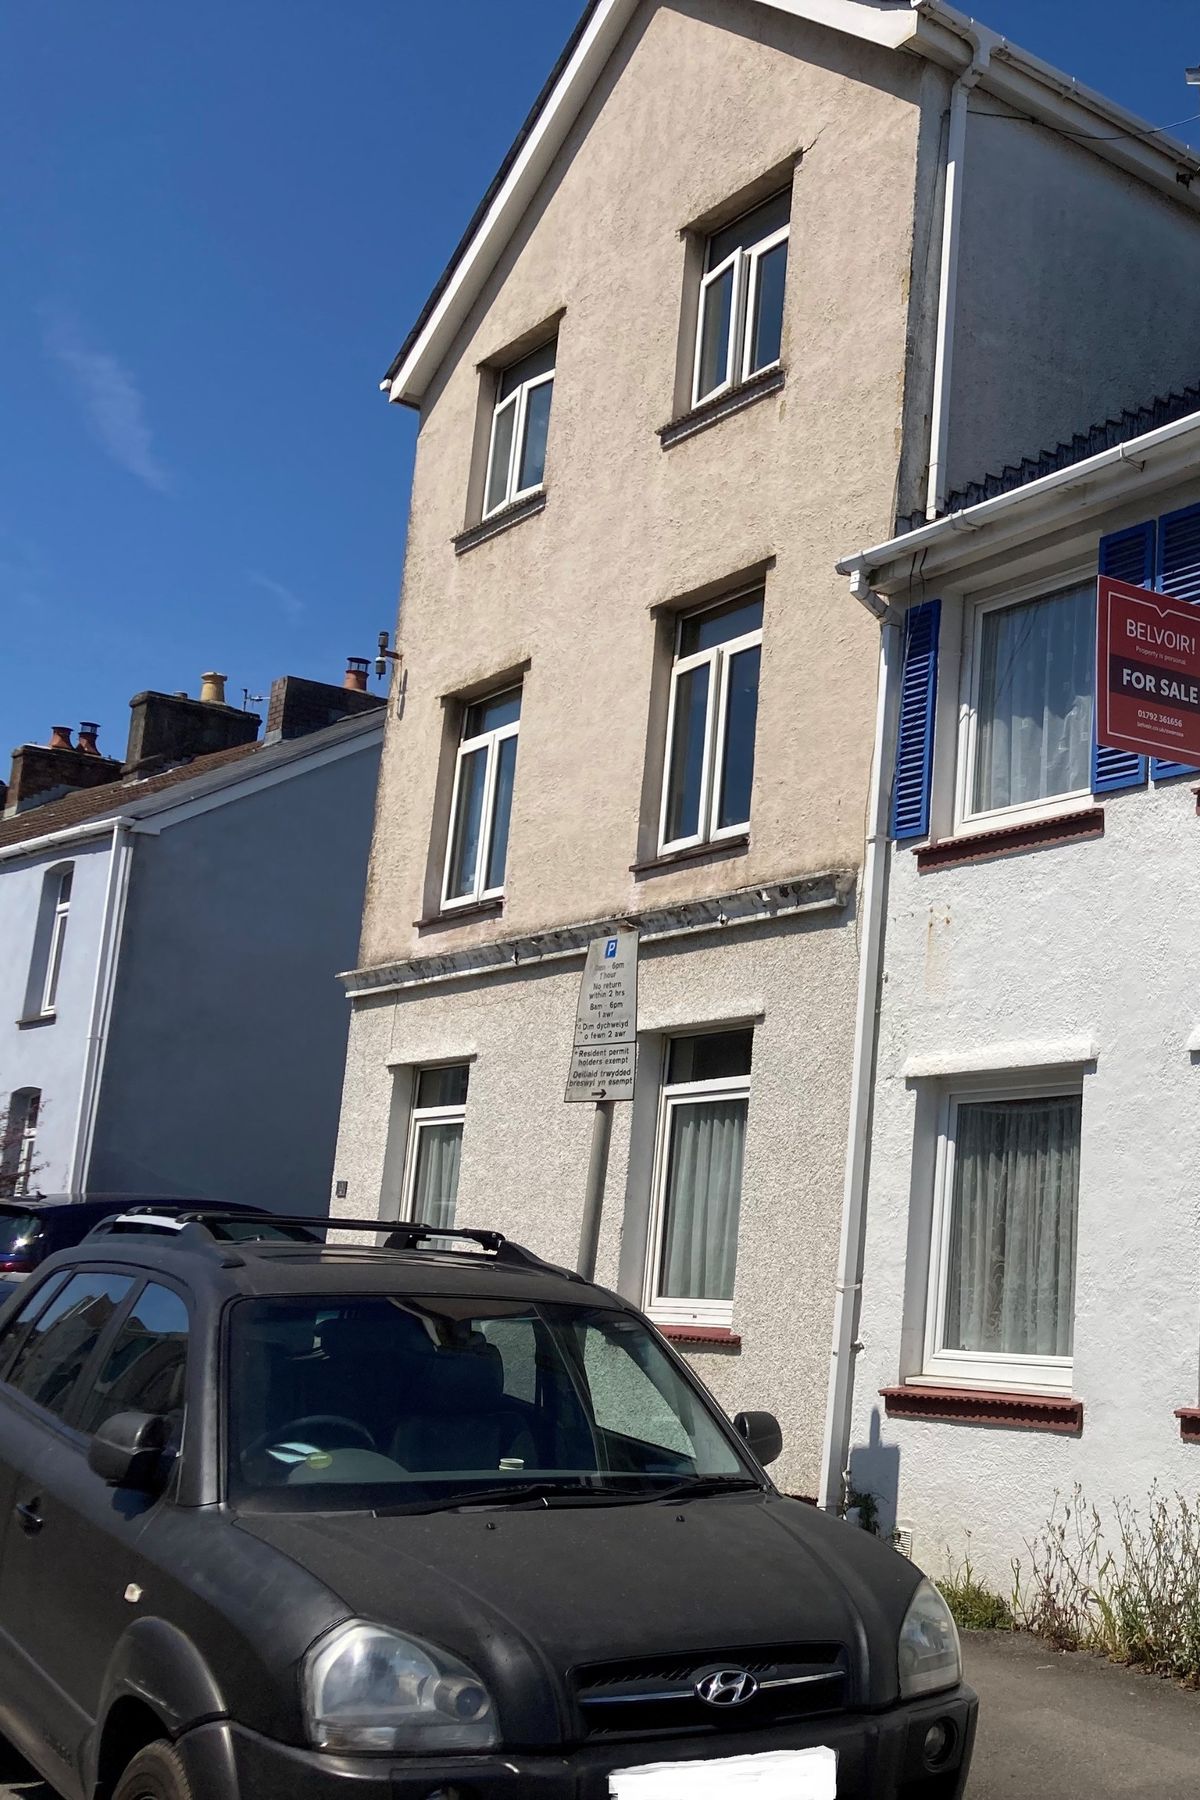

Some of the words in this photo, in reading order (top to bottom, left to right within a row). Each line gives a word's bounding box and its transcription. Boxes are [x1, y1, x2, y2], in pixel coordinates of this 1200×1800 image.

[1126, 618, 1196, 655] BELVOIR!
[1122, 668, 1156, 694] FOR
[1160, 678, 1199, 704] SALE
[1137, 709, 1158, 722] 01792
[1159, 714, 1183, 728] 361656
[612, 962, 625, 970] 6pm
[603, 981, 622, 990] return
[589, 991, 607, 1000] within
[608, 989, 613, 997] 2
[590, 1002, 602, 1010] 8am
[609, 1001, 624, 1010] 6pm
[583, 1022, 594, 1030] Dim
[596, 1019, 629, 1031] dychwelyd
[590, 1031, 606, 1039] fewn
[607, 1030, 612, 1038] 2
[614, 1030, 626, 1038] awr
[578, 1049, 607, 1058] Resident
[609, 1047, 629, 1056] permit
[577, 1057, 603, 1066] holders
[604, 1056, 629, 1065] exempt
[600, 1068, 632, 1078] trwydded
[597, 1079, 606, 1087] yn
[608, 1077, 633, 1086] esempt
